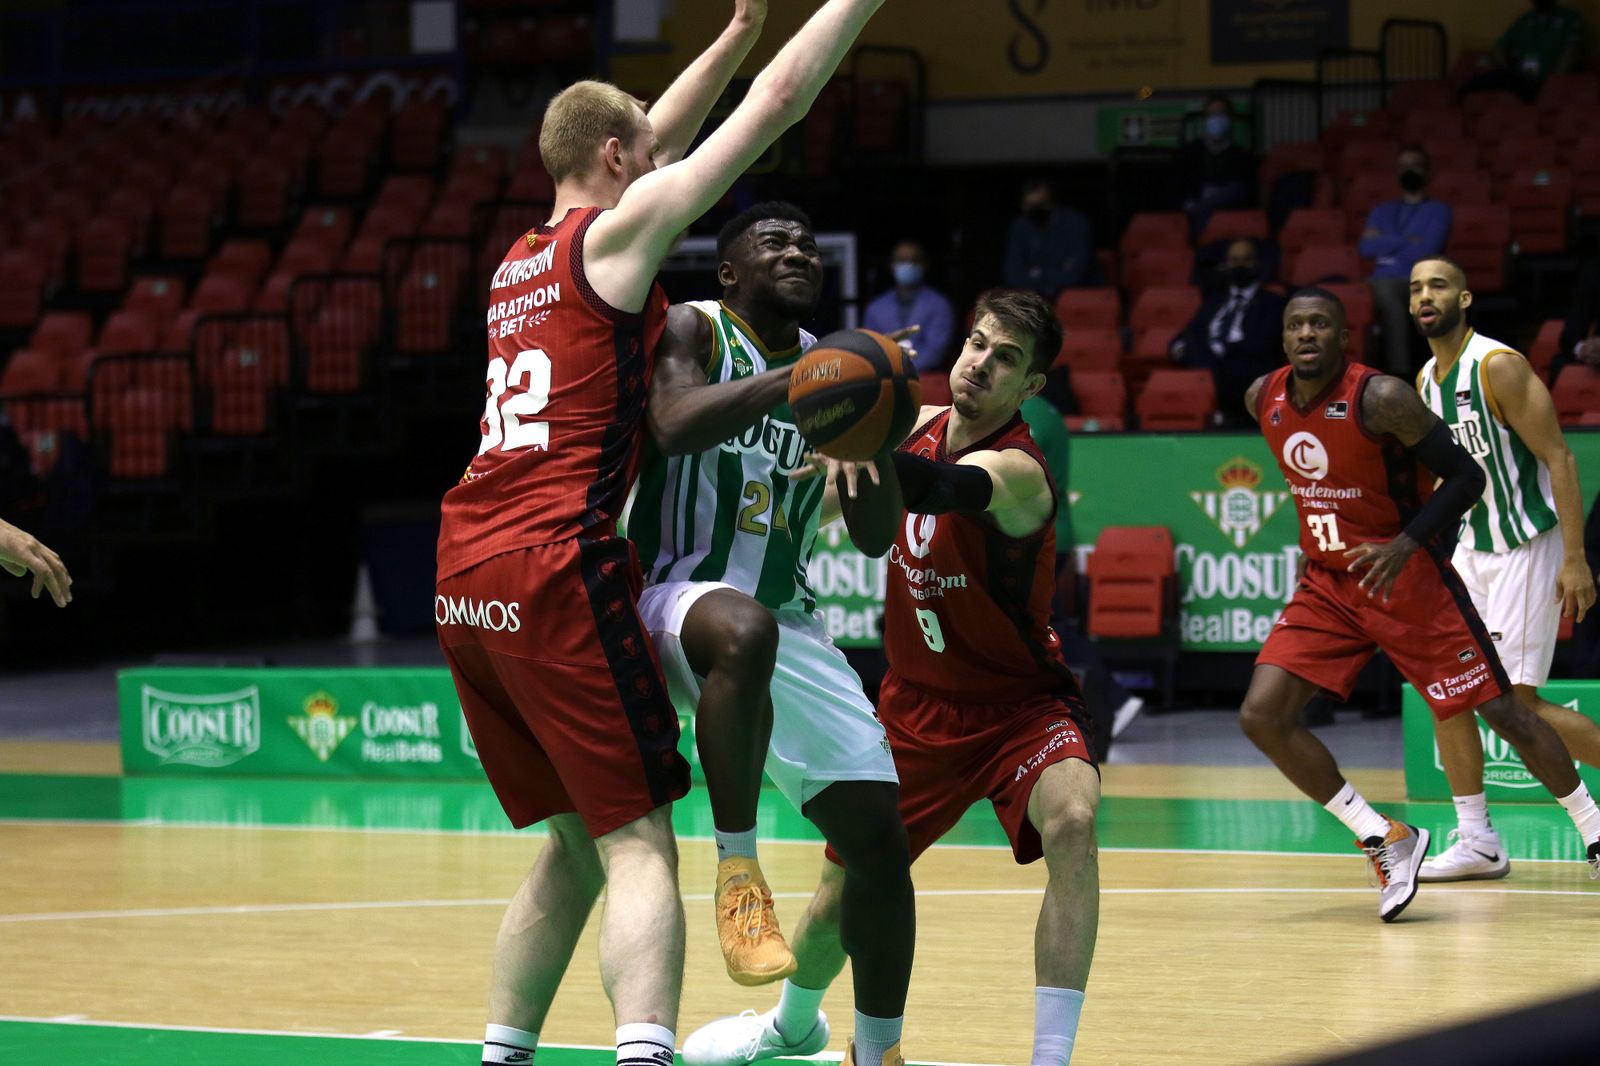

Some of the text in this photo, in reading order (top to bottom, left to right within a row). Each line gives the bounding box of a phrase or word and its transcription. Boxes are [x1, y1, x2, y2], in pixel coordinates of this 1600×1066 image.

[499, 314, 527, 339] BET
[477, 349, 552, 457] 32
[1307, 513, 1347, 552] 31
[915, 607, 946, 653] 9
[1443, 663, 1486, 688] Zaragoza
[1447, 672, 1490, 697] DEPORTE
